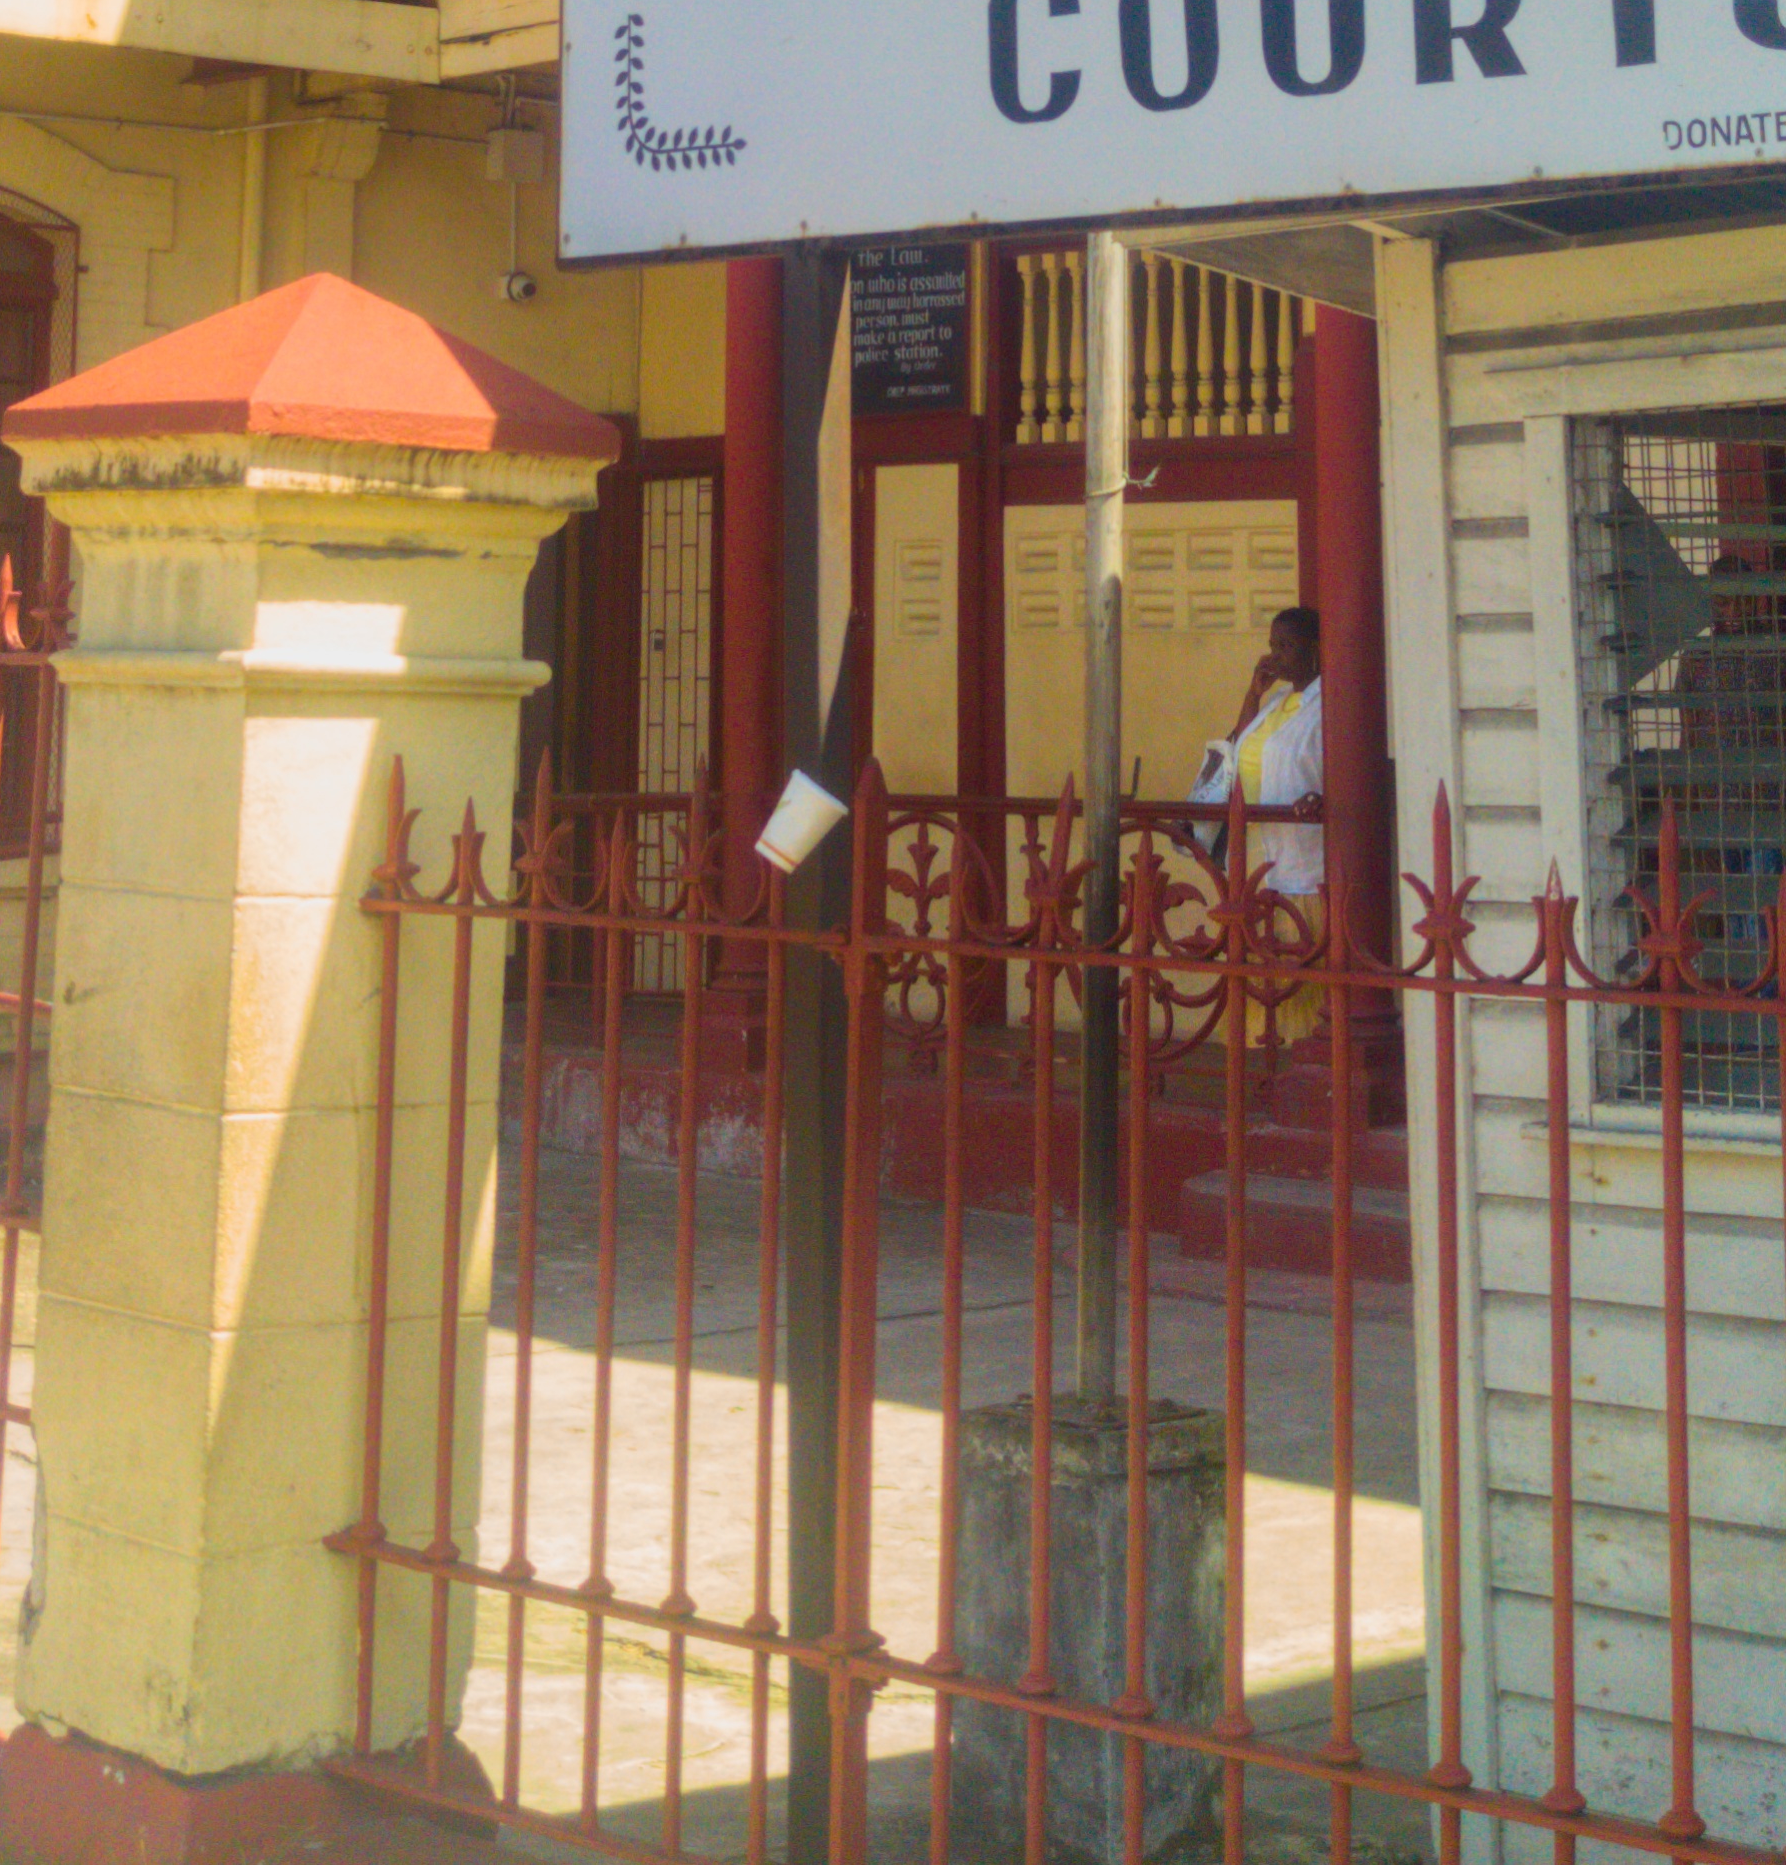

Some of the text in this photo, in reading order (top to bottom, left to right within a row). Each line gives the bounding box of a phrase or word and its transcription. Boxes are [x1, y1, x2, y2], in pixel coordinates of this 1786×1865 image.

[868, 275, 895, 294] who
[897, 271, 907, 292] is
[910, 270, 965, 291] assaulted
[864, 297, 886, 314] any
[887, 295, 911, 312] way
[853, 325, 953, 347] make a report to
[854, 347, 889, 368] police
